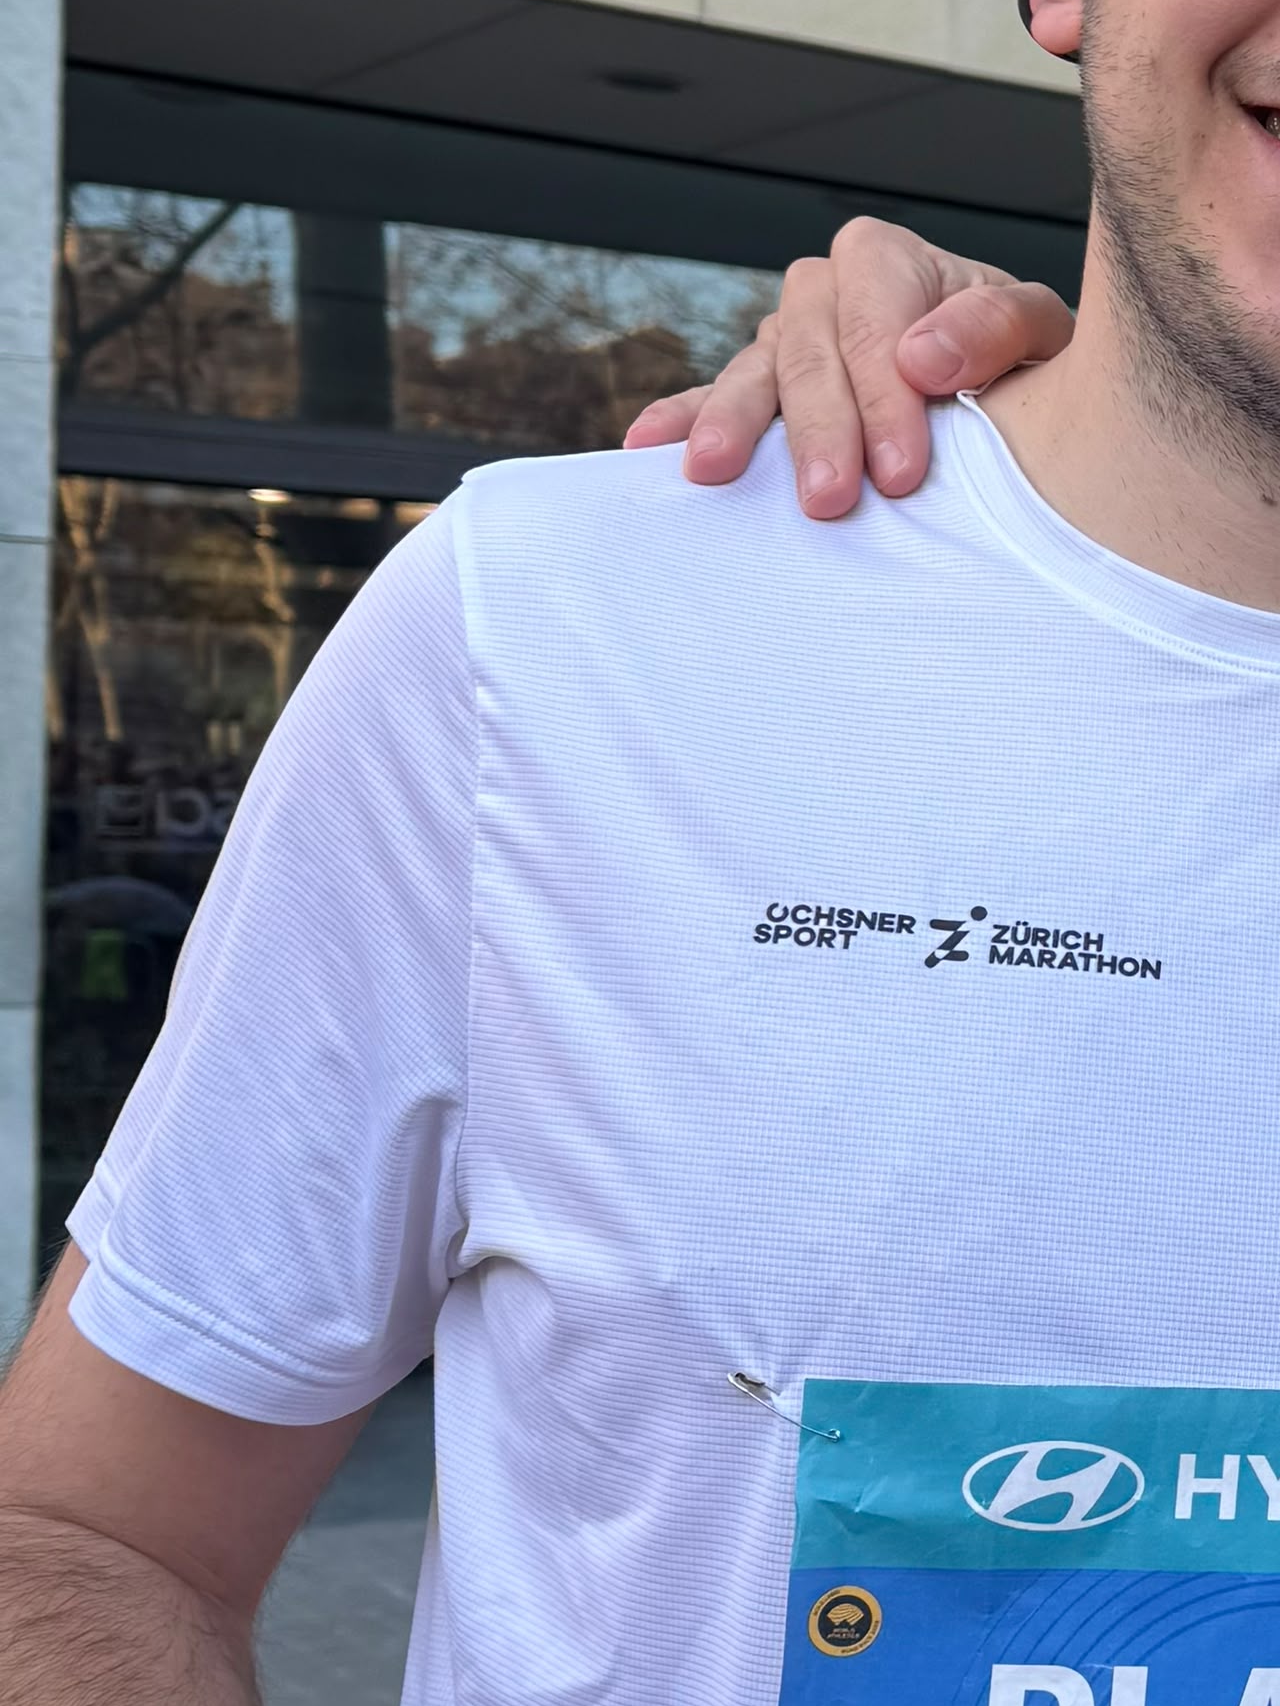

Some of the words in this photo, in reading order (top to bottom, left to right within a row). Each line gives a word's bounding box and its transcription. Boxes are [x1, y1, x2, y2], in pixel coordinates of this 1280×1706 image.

[766, 902, 916, 934] OCHSNER
[753, 923, 858, 950] SPORT
[990, 921, 1104, 952] ZÜRICH
[988, 945, 1163, 980] MARATHON
